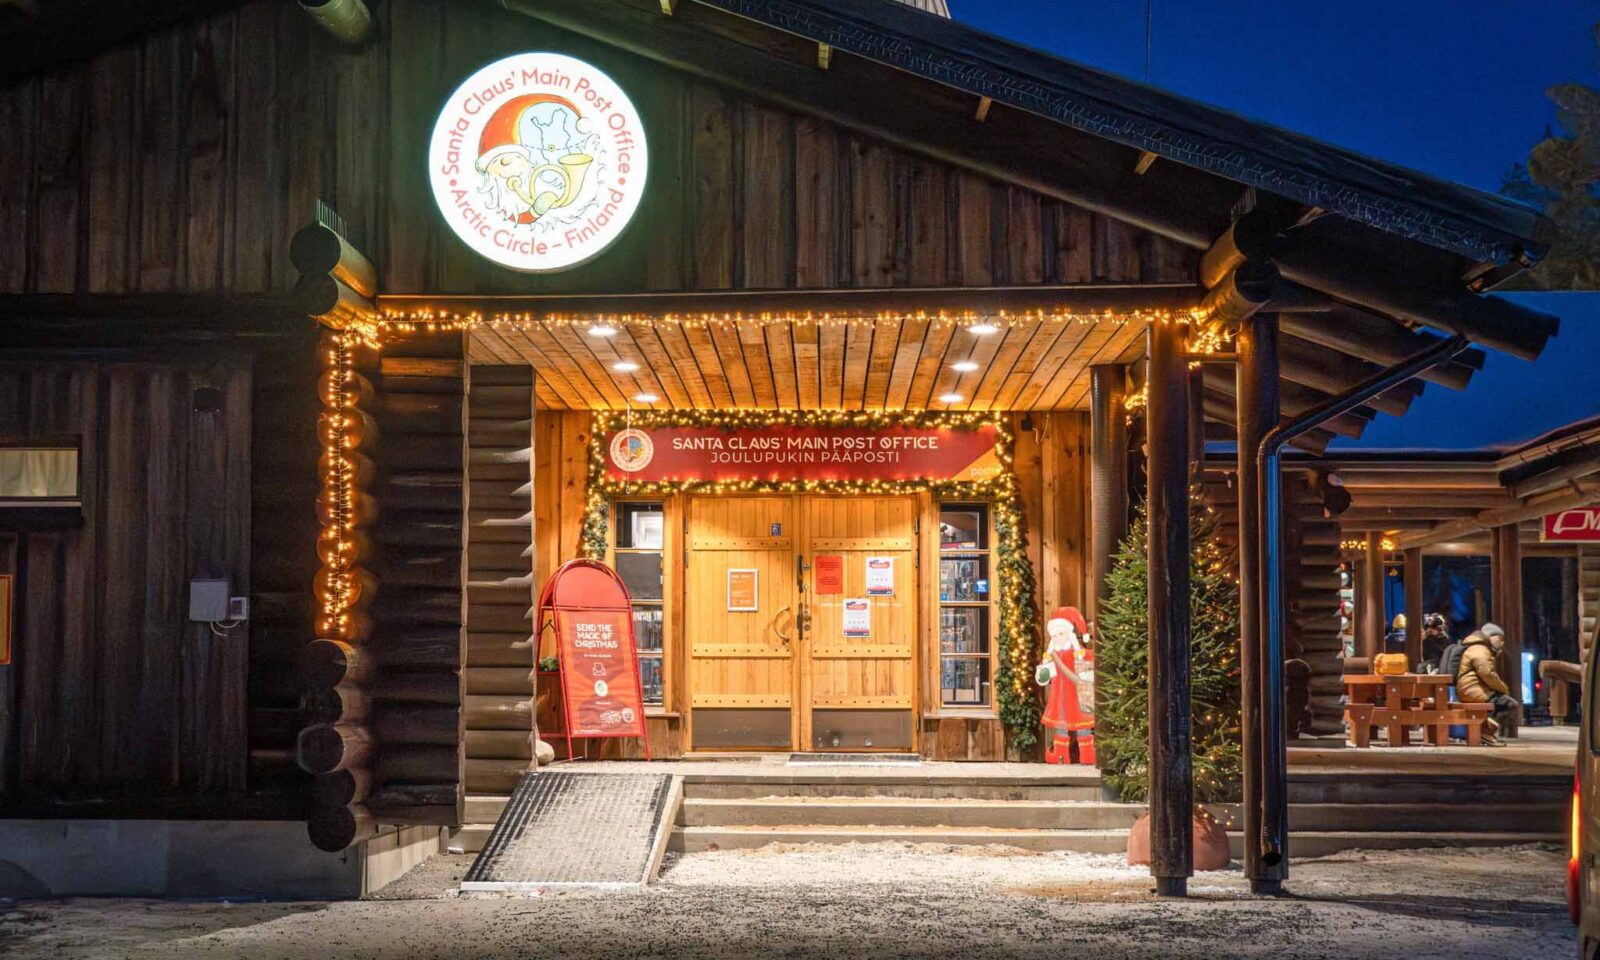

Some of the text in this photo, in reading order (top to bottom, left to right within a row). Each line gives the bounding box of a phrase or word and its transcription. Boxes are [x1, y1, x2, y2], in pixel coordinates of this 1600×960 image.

[442, 67, 636, 176] Santa Claus' Main Post Office
[450, 189, 493, 239] Arctic
[493, 228, 548, 256] Circle
[564, 187, 626, 249] Finland
[672, 437, 724, 450] SANTA
[787, 437, 828, 450] MAIN
[832, 437, 876, 450] POST
[879, 437, 939, 450] OFFICE
[710, 449, 900, 464] JOULUPUKIN PÄÄPOSTI
[576, 623, 613, 633] SEND THE
[577, 632, 613, 640] MAGIC OF
[575, 640, 618, 649] CHRISTMAS
